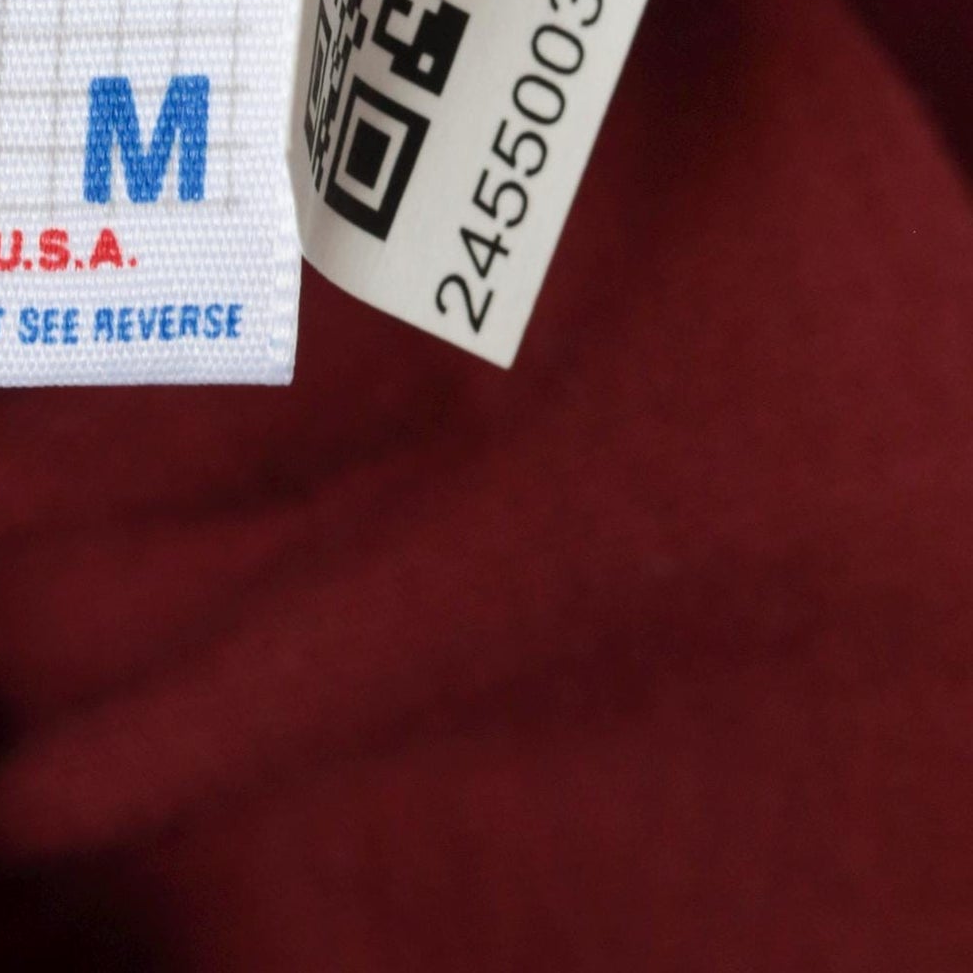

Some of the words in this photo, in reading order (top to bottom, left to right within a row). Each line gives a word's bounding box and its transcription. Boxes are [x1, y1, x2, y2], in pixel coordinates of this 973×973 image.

[82, 73, 211, 204] M
[17, 306, 80, 345] SEE
[93, 302, 243, 343] REVERSE
